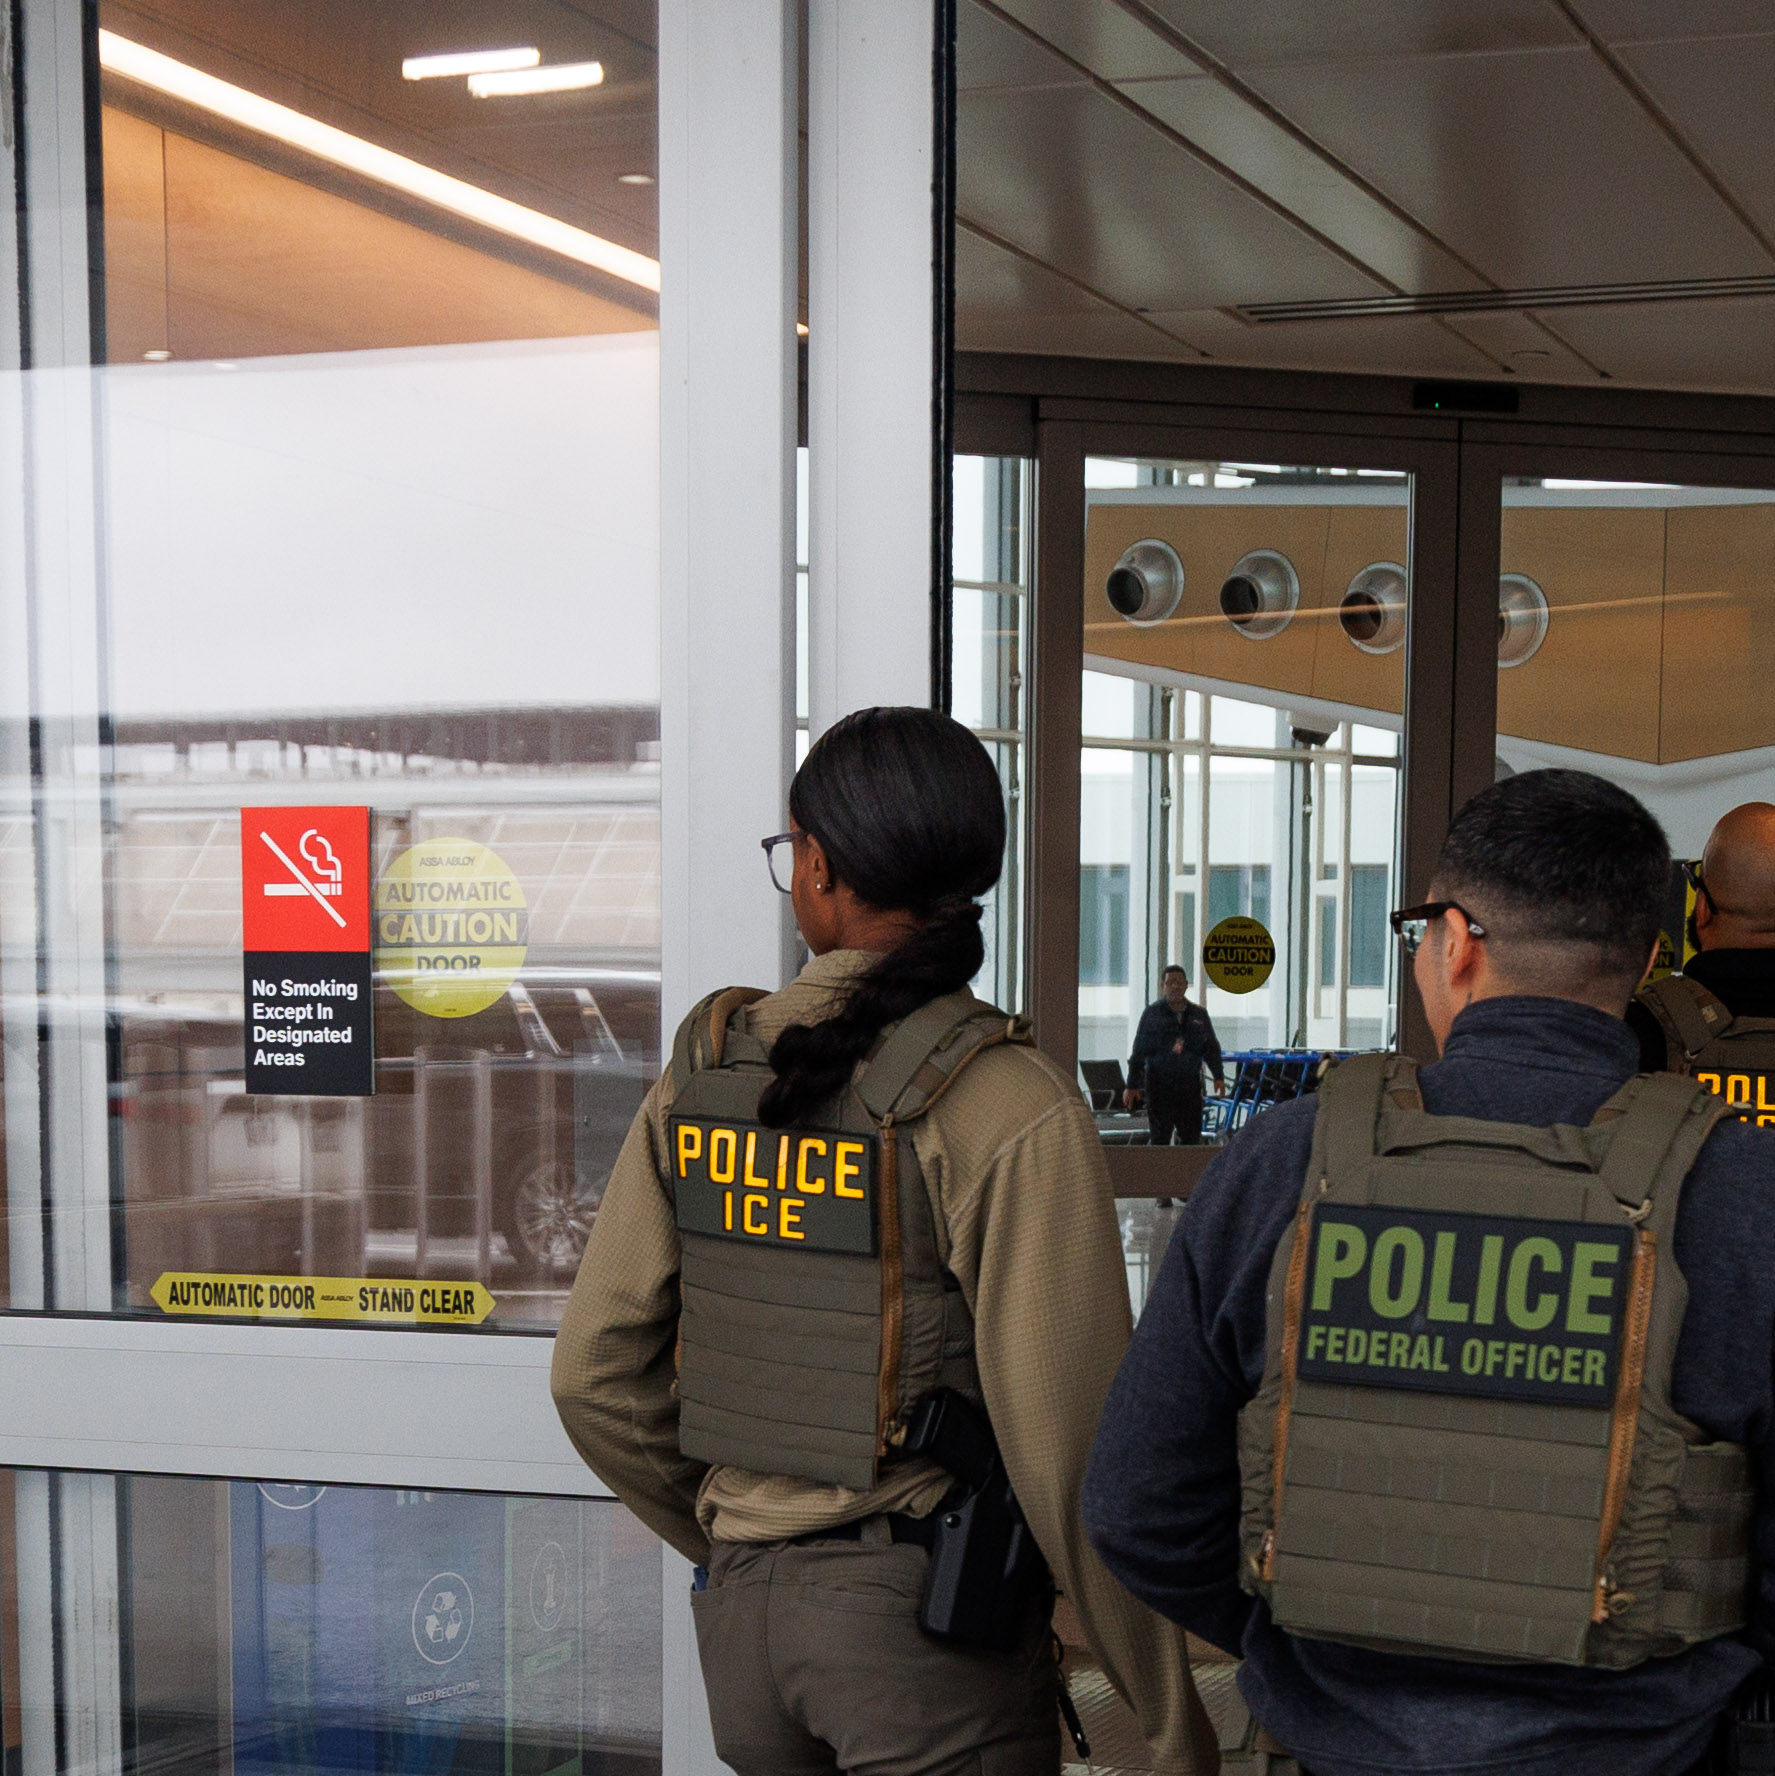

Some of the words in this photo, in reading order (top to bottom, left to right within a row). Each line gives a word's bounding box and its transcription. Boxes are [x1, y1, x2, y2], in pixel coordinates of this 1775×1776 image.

[386, 881, 512, 903] AUTOMATIC
[379, 912, 518, 944] CAUTION
[1210, 934, 1270, 945] AUTOMATIC
[417, 954, 481, 974] DOOR
[1208, 948, 1271, 962] CAUTION
[1223, 966, 1254, 976] DOOR
[252, 979, 277, 997] No
[281, 979, 358, 1001] Smoking
[253, 1002, 314, 1024] Except
[317, 1002, 334, 1020] In
[253, 1026, 352, 1047] Designated
[253, 1048, 306, 1067] Areas
[677, 1124, 864, 1199] POLICE
[725, 1191, 805, 1239] ICE
[1311, 1222, 1620, 1335] POLICE
[168, 1281, 264, 1308] AUTOMATIC
[269, 1284, 316, 1310] DOOR
[359, 1287, 414, 1313] STAND
[420, 1289, 476, 1315] CLEAR
[1306, 1325, 1450, 1372] FEDERAL
[1461, 1338, 1607, 1386] OFFICER
[406, 1690, 435, 1705] MIXED
